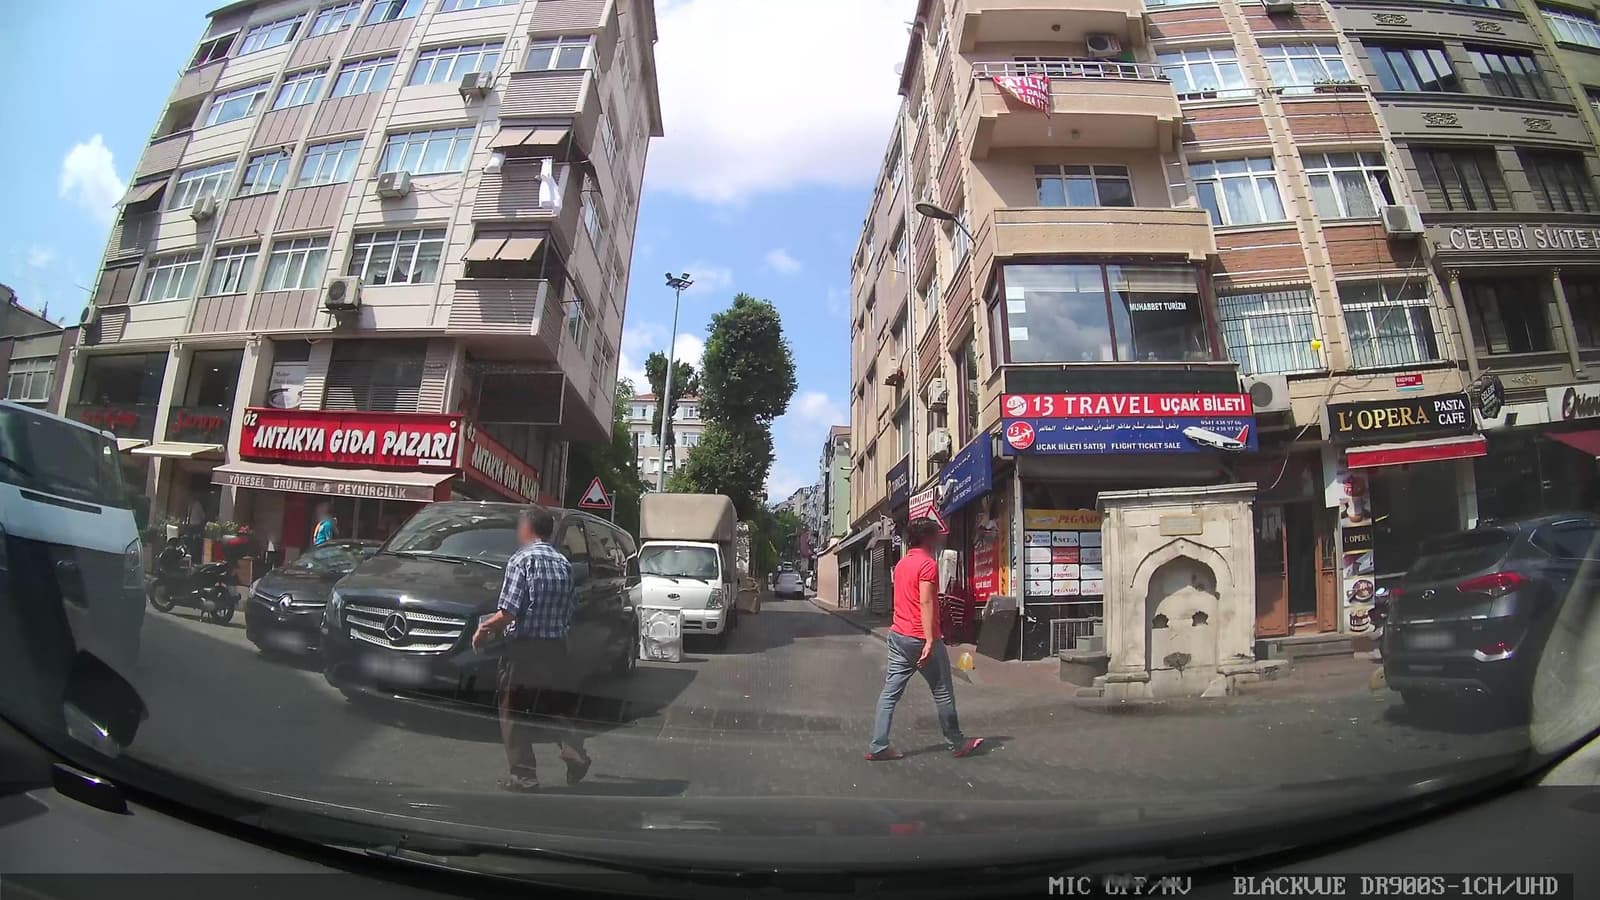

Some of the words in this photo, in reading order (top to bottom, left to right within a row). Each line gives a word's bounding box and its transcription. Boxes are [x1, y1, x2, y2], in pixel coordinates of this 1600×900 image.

[1129, 302, 1162, 311] MUHABBET
[1033, 396, 1054, 417] 13
[1063, 396, 1154, 415] TRAVEL
[1160, 398, 1200, 415] UÇAK
[1203, 395, 1246, 412] BİLETİ
[1434, 399, 1466, 412] PASTA
[1337, 405, 1430, 432] L'OPERA
[1438, 412, 1466, 426] CAFE
[252, 425, 326, 453] ANTAKYA
[329, 428, 376, 455] GIDA
[1036, 443, 1057, 452] UÇAK
[1111, 441, 1136, 450] FLIGHT
[1138, 441, 1162, 450] TICKET
[1164, 441, 1181, 449] SALE
[471, 442, 504, 485] ANTAKYA
[229, 475, 265, 489] YÖRESEL
[273, 476, 316, 492] ÜRÜNLER
[323, 483, 331, 493] &
[337, 484, 406, 499] PEYNİRCİLİK
